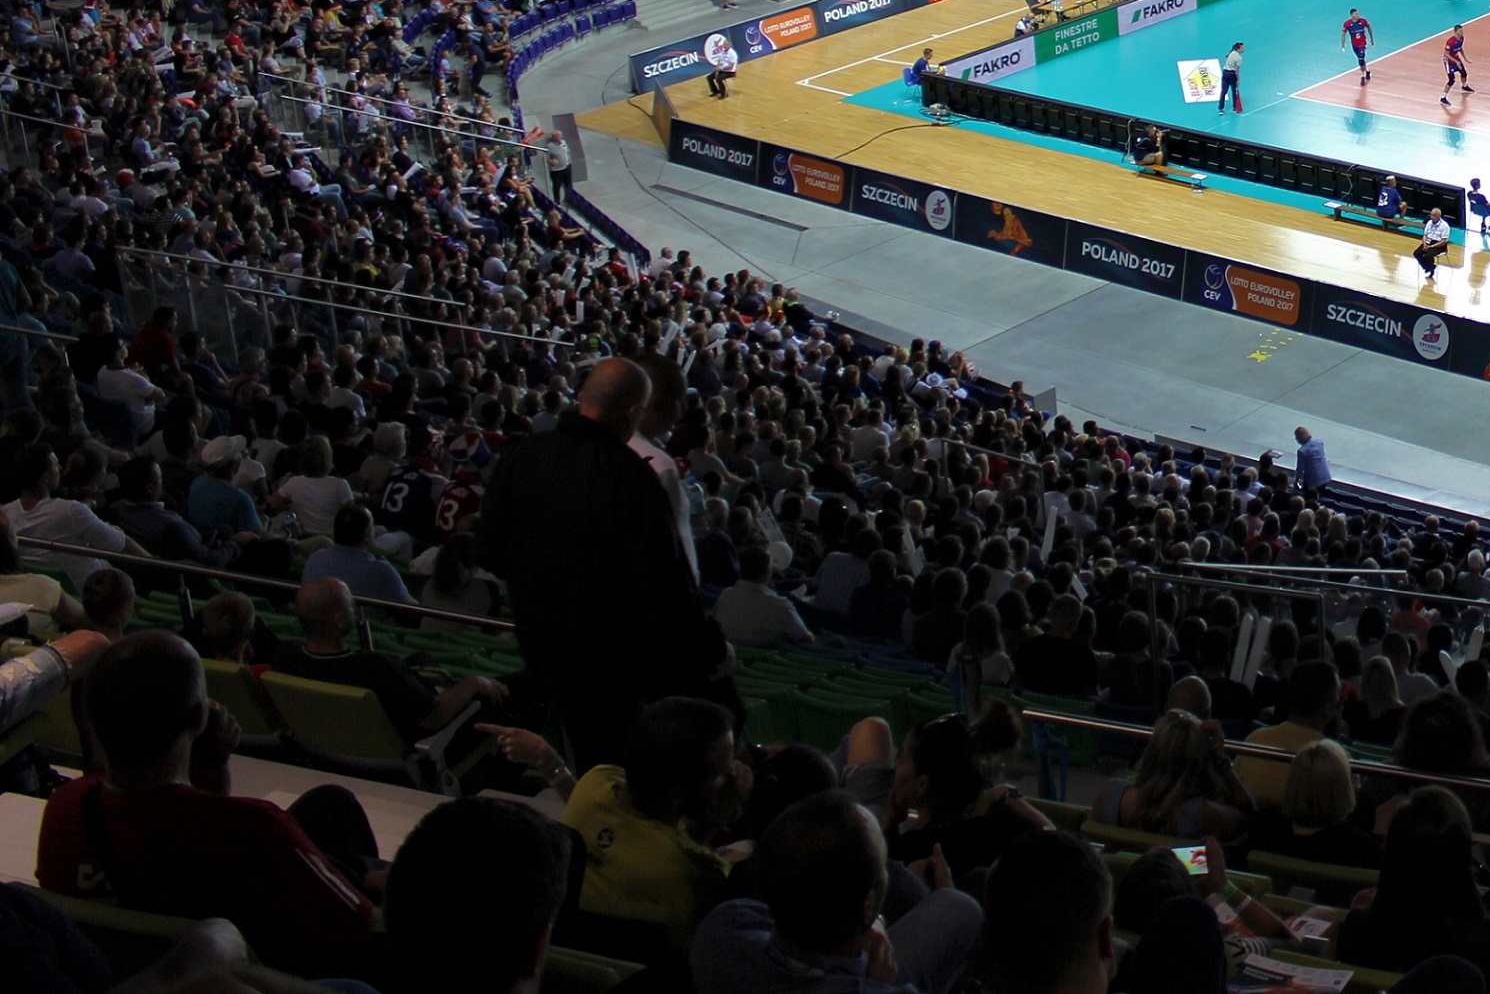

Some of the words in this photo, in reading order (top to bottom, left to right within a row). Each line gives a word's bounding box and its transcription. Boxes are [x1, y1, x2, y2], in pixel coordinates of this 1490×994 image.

[824, 2, 868, 23] POLAND
[764, 23, 780, 34] LOTTO
[780, 15, 810, 30] EUROVOLLEY
[780, 26, 800, 38] POLAND
[800, 23, 812, 33] 2017
[1055, 19, 1098, 41] FINESTRE
[749, 44, 763, 54] CEV
[1055, 42, 1069, 55] DA
[1071, 31, 1100, 50] TETTO
[643, 51, 699, 78] SZCZECIN
[973, 51, 1021, 78] FAKRO
[682, 137, 726, 160] POLAND
[727, 149, 753, 167] 2017
[772, 176, 787, 186] CEV
[792, 164, 806, 174] LOTTO
[806, 167, 841, 182] EUROVOLLEY
[804, 177, 826, 190] POLAND
[826, 182, 840, 193] 2017
[861, 184, 918, 212] SZCZECIN
[1081, 241, 1140, 270] POLAND
[1141, 258, 1175, 279] 2017
[1203, 289, 1221, 301] CEV
[1230, 276, 1249, 289] LOTTO
[1249, 281, 1295, 300] EUROVOLLEY
[1247, 293, 1275, 308] POLAND
[1276, 299, 1294, 312] 2017
[1326, 304, 1402, 337] SZCZECIN
[381, 481, 410, 513] 13
[435, 496, 459, 531] 13
